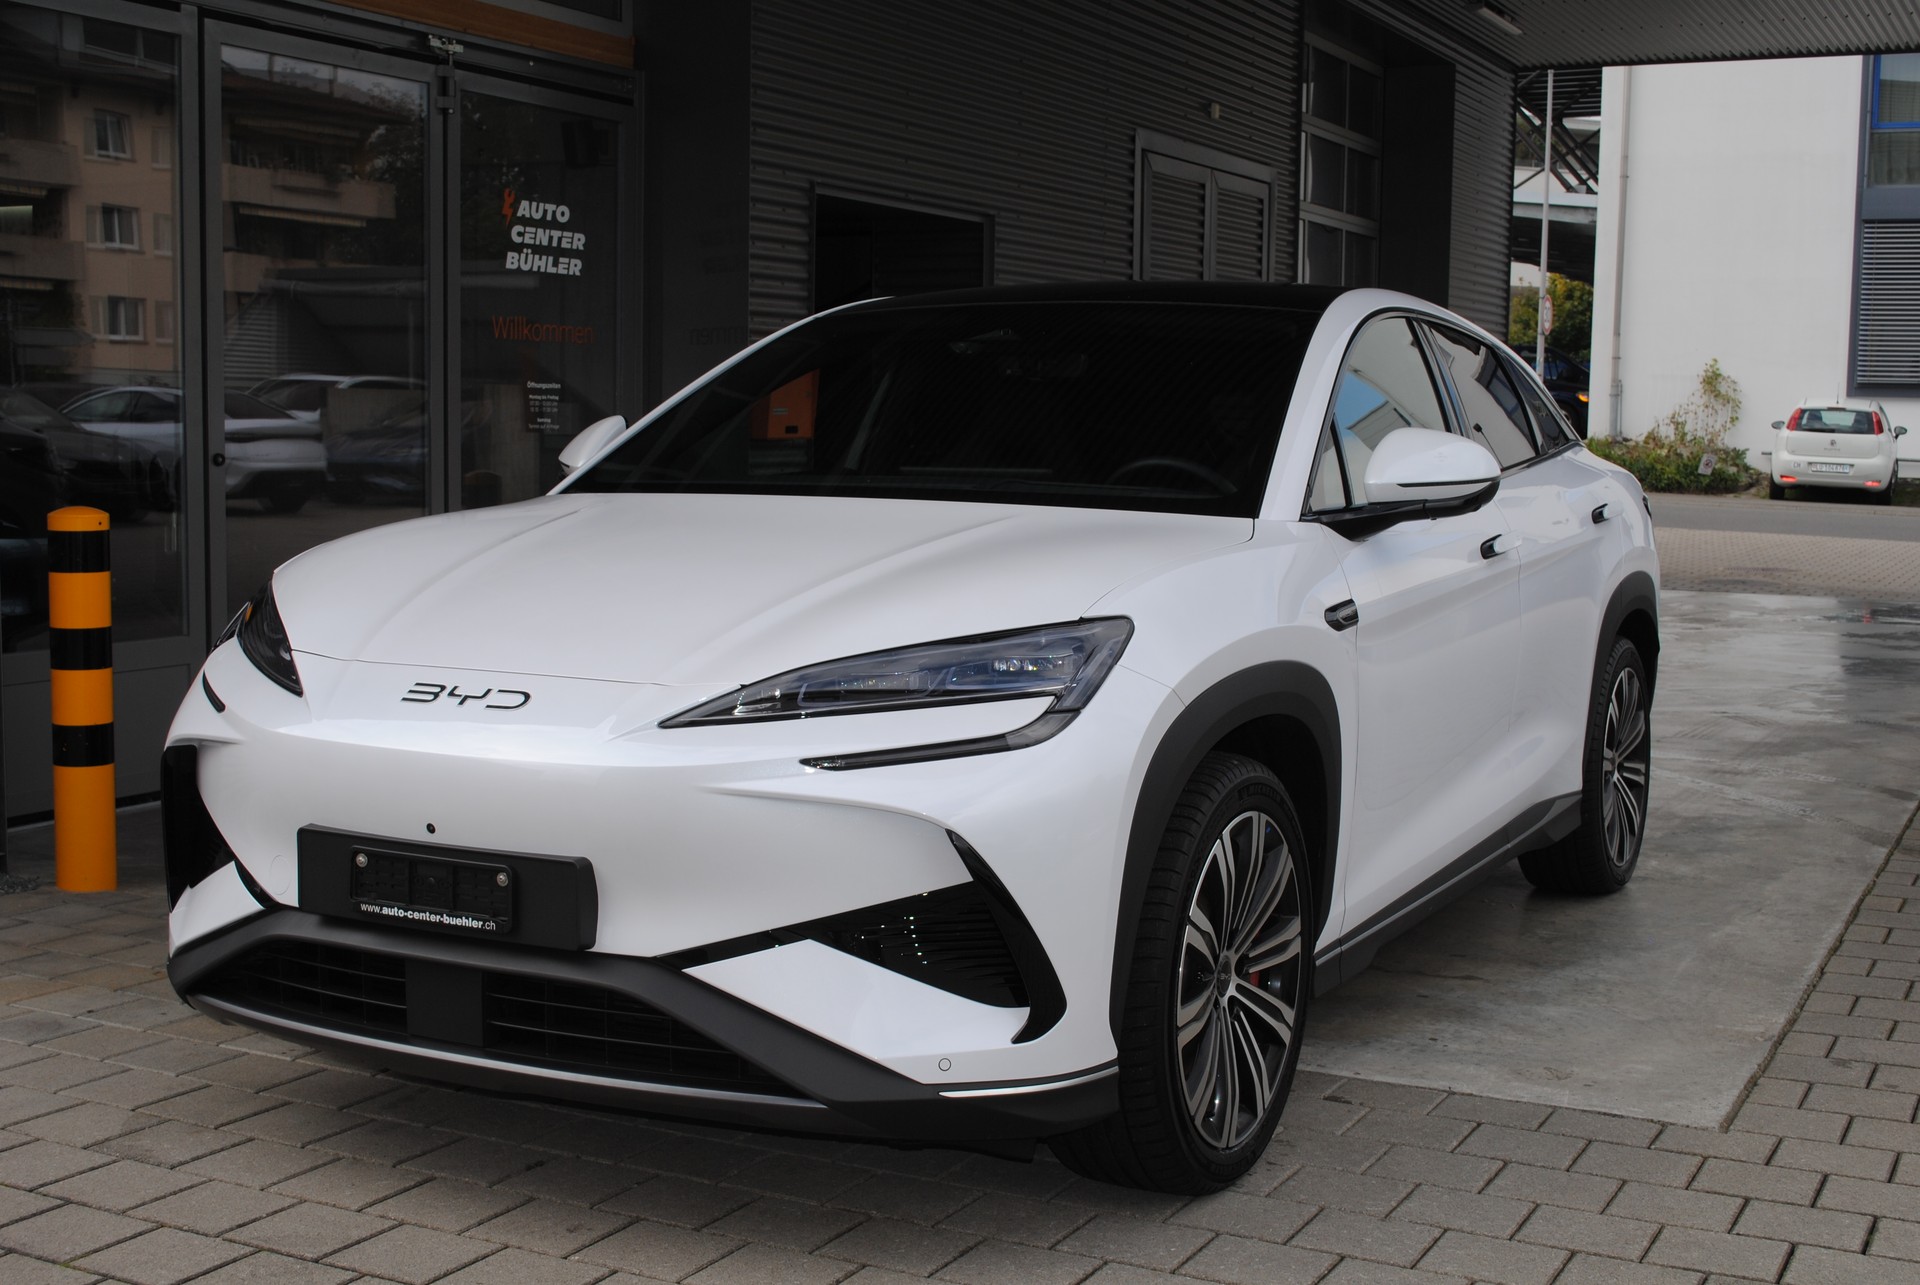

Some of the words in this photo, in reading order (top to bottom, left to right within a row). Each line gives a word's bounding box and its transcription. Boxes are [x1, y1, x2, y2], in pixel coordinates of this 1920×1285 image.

[516, 200, 570, 224] AUTO
[510, 225, 586, 251] CENTER
[505, 248, 583, 276] BÜHLER
[492, 315, 595, 345] Willkommen
[400, 682, 533, 710] BYD
[360, 903, 496, 931] www.auto-center-buehler.ch
